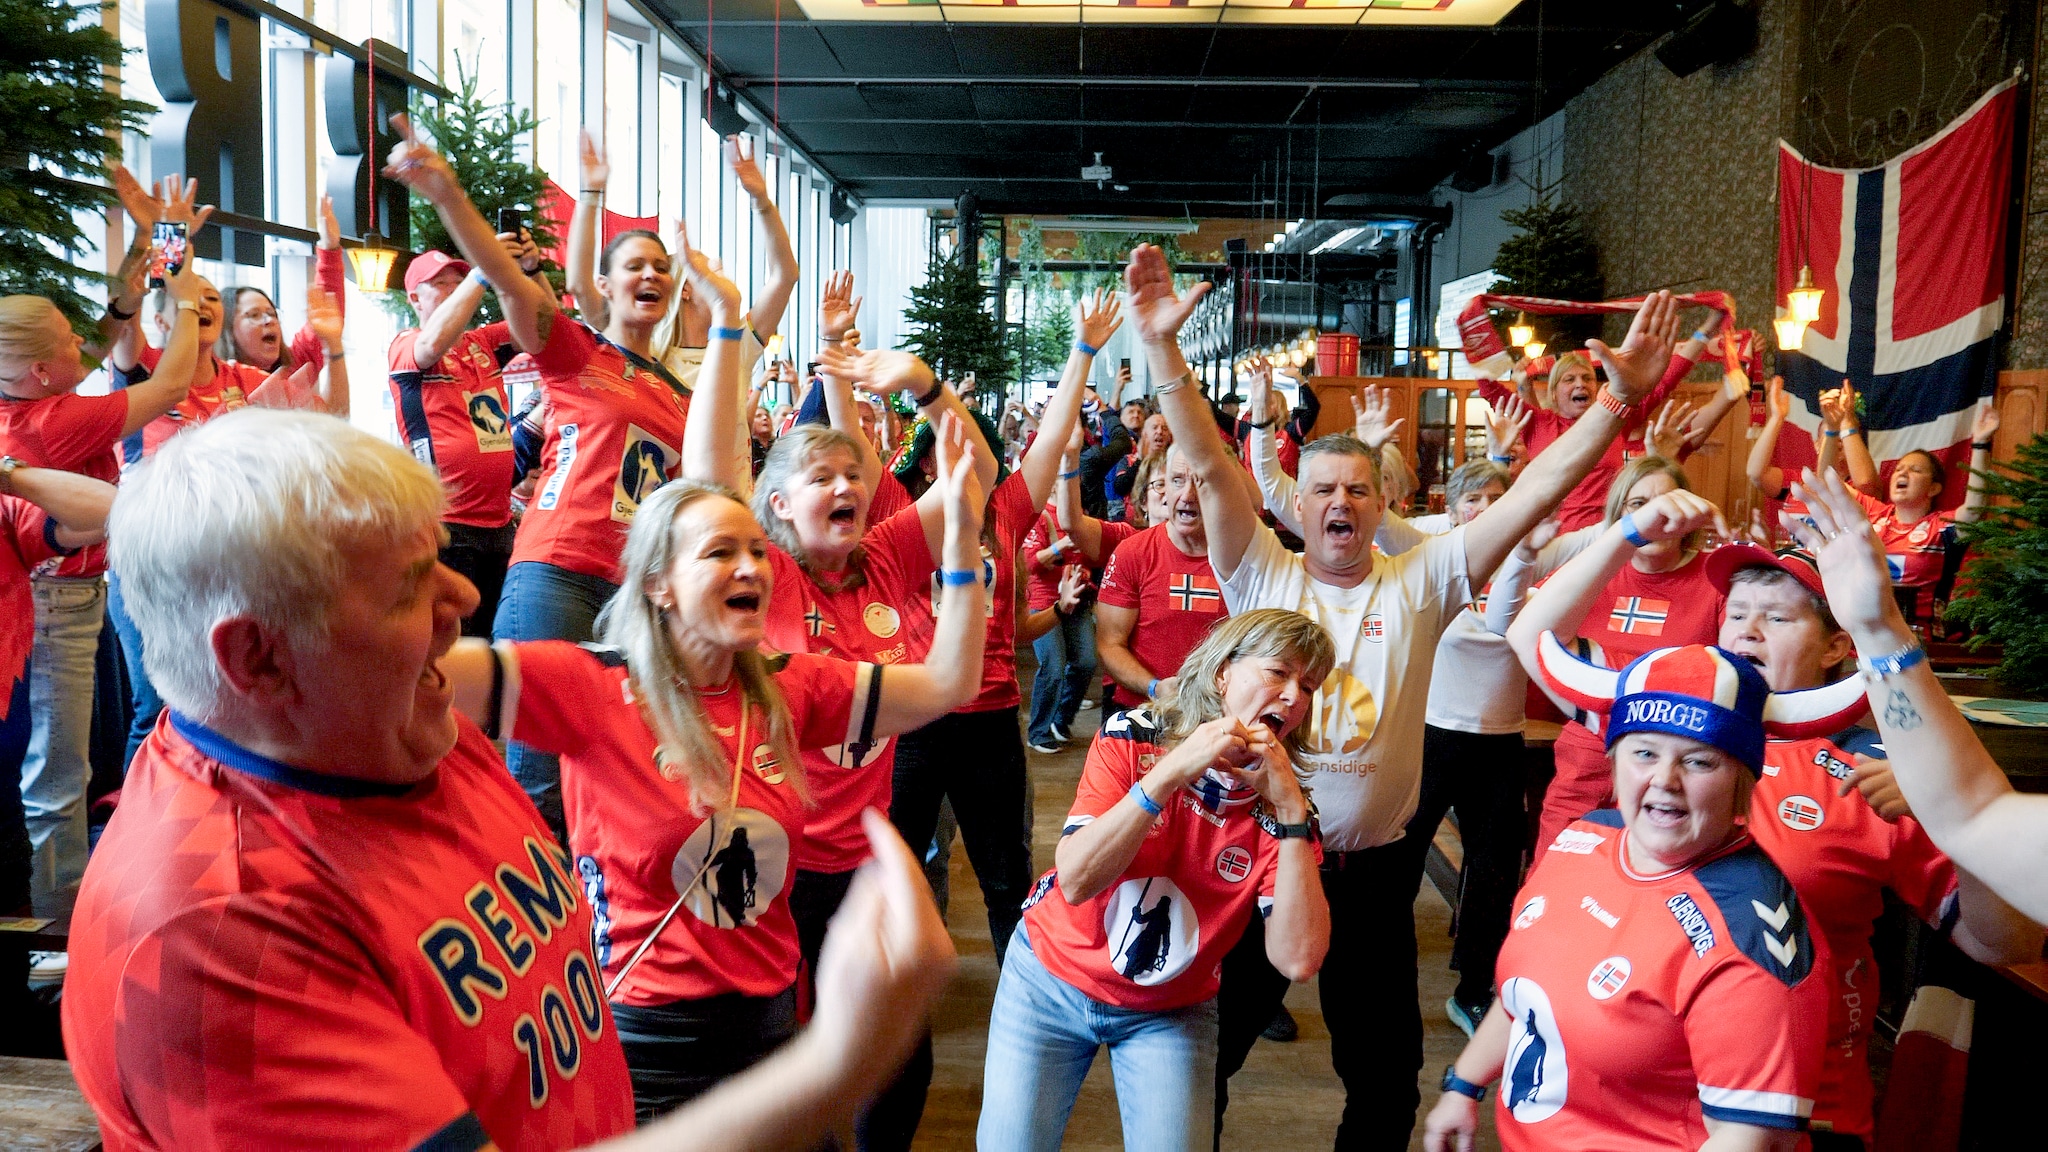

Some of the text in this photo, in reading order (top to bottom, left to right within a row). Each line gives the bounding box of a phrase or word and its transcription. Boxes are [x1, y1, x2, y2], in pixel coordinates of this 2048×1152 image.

[1309, 759, 1377, 777] ensidige
[1623, 699, 1709, 732] NORGE
[417, 834, 582, 1028] REM
[513, 921, 609, 1110] 100
